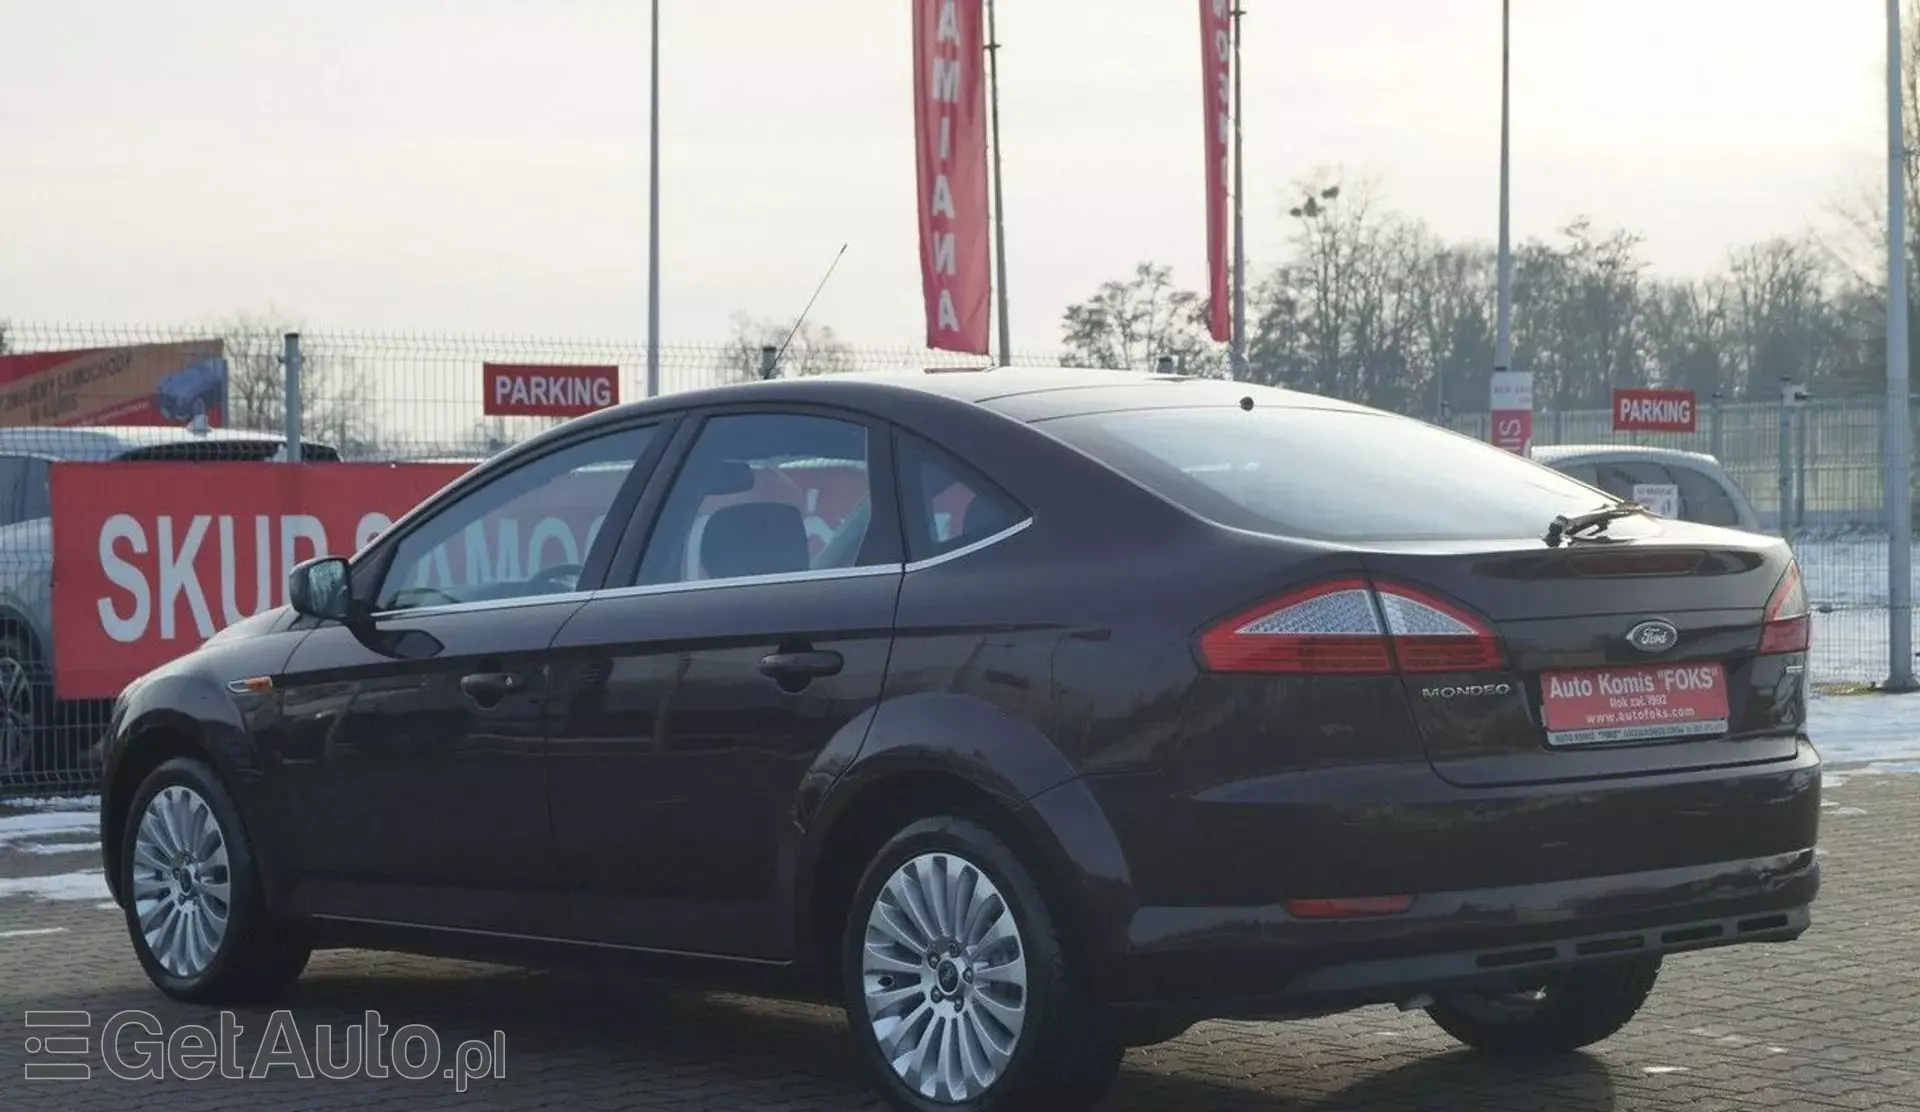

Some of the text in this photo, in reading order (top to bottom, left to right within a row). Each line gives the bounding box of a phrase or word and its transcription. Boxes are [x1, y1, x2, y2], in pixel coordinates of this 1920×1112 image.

[495, 375, 612, 406] PARKING
[1620, 398, 1690, 423] PARKING
[97, 513, 329, 643] SKUP
[1640, 628, 1668, 645] Ford
[1421, 683, 1511, 699] MONDEO
[1550, 667, 1718, 699] Auto Komis "FOKS"
[1586, 707, 1695, 724] www.autofoks.com
